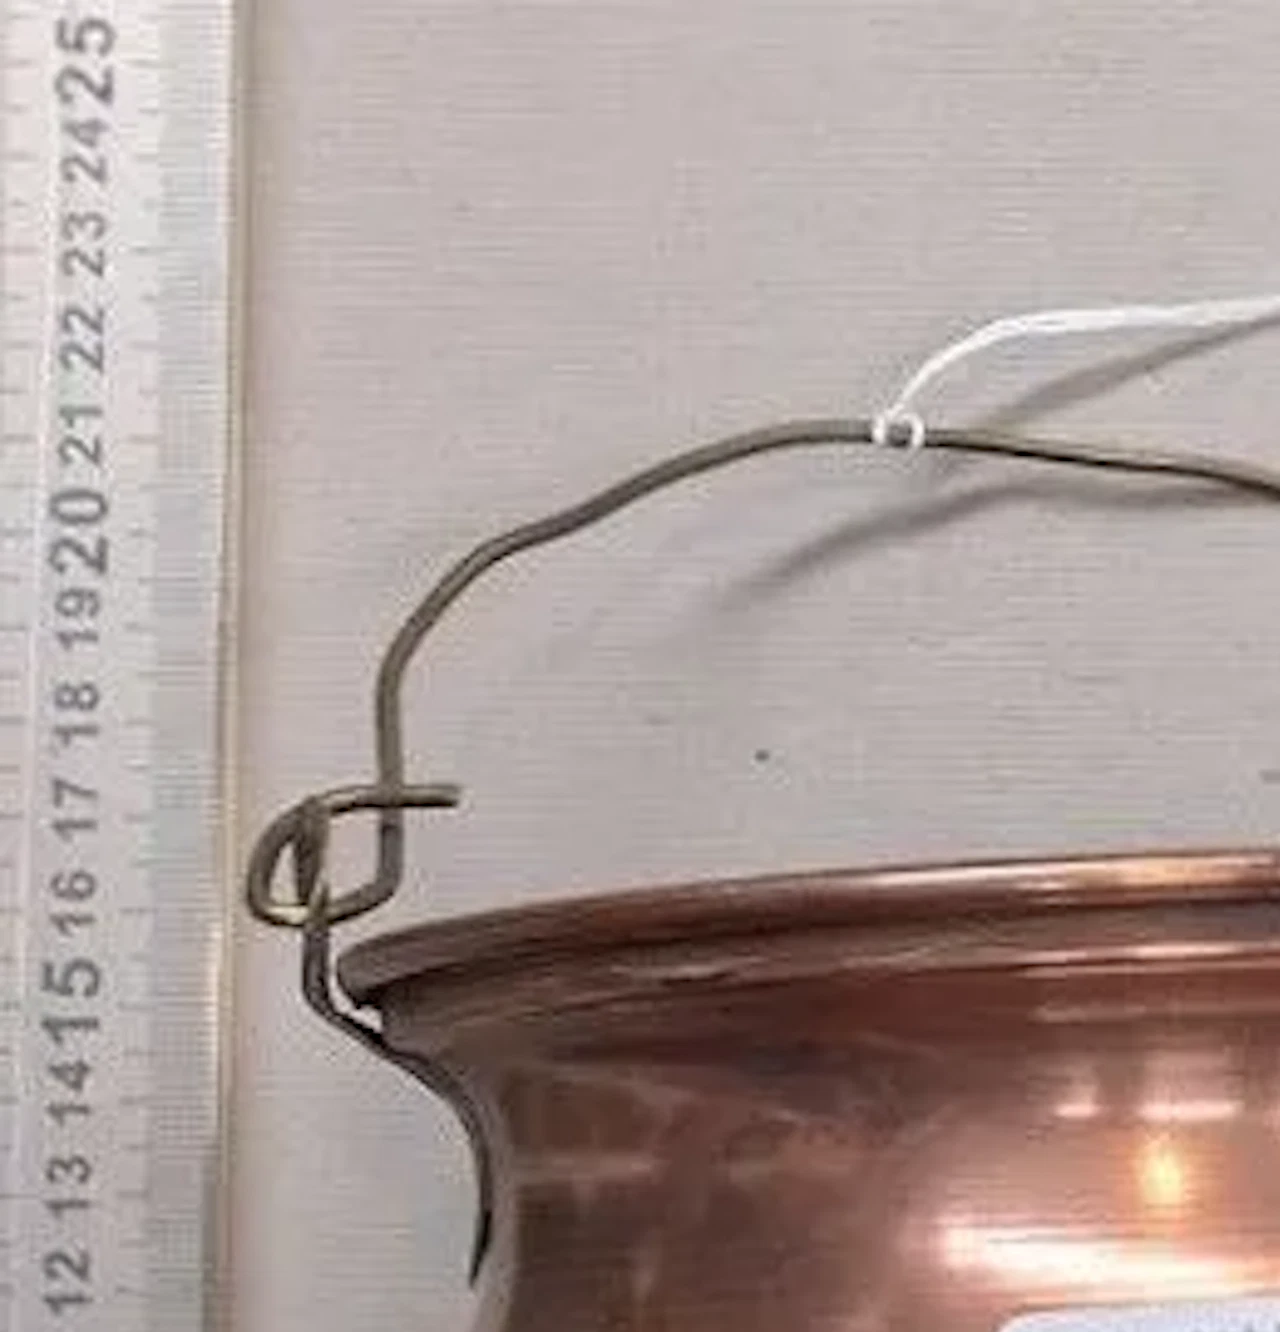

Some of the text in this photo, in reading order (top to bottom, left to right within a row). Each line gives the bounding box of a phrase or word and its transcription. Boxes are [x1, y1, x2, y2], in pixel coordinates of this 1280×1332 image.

[53, 15, 117, 108] 25
[59, 117, 110, 190] 24
[58, 211, 109, 280] 23
[56, 303, 106, 376] 22
[57, 404, 104, 469] 21
[46, 486, 110, 578] 20
[53, 586, 102, 652] 19
[51, 679, 102, 748] 18
[50, 777, 99, 842] 17
[49, 868, 98, 937] 16
[40, 957, 103, 1048] 15
[45, 1057, 94, 1128] 14
[44, 1155, 93, 1220] 13
[42, 1250, 92, 1316] 12
